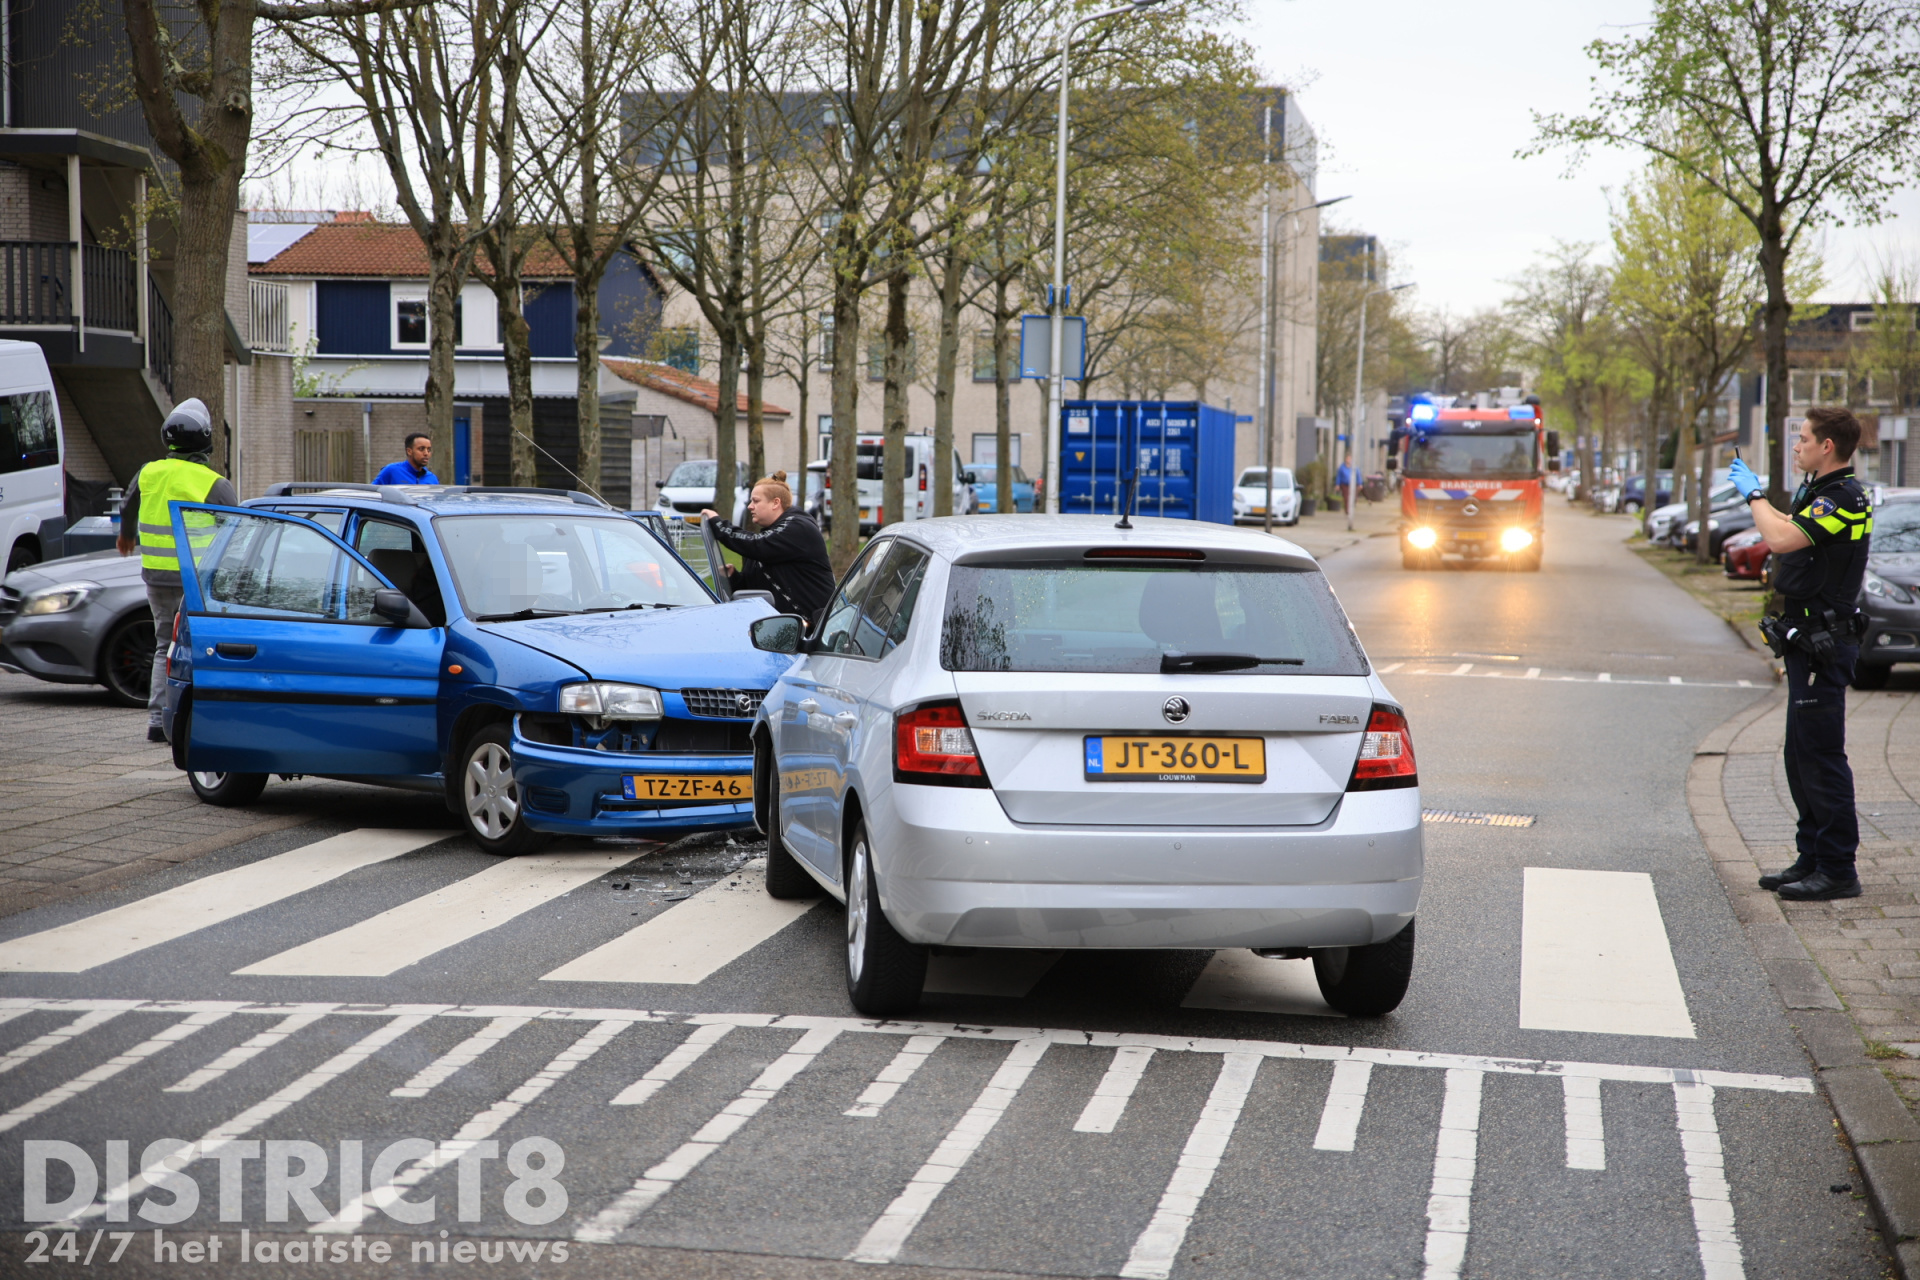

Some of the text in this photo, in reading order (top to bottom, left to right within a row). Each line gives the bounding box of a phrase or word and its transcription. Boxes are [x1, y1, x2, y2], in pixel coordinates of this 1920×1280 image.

[1319, 714, 1359, 724] FABIA
[1115, 742, 1250, 769] JT-360-L
[1088, 758, 1100, 767] NL
[624, 786, 635, 795] NL
[643, 779, 742, 796] TZ-ZF-46
